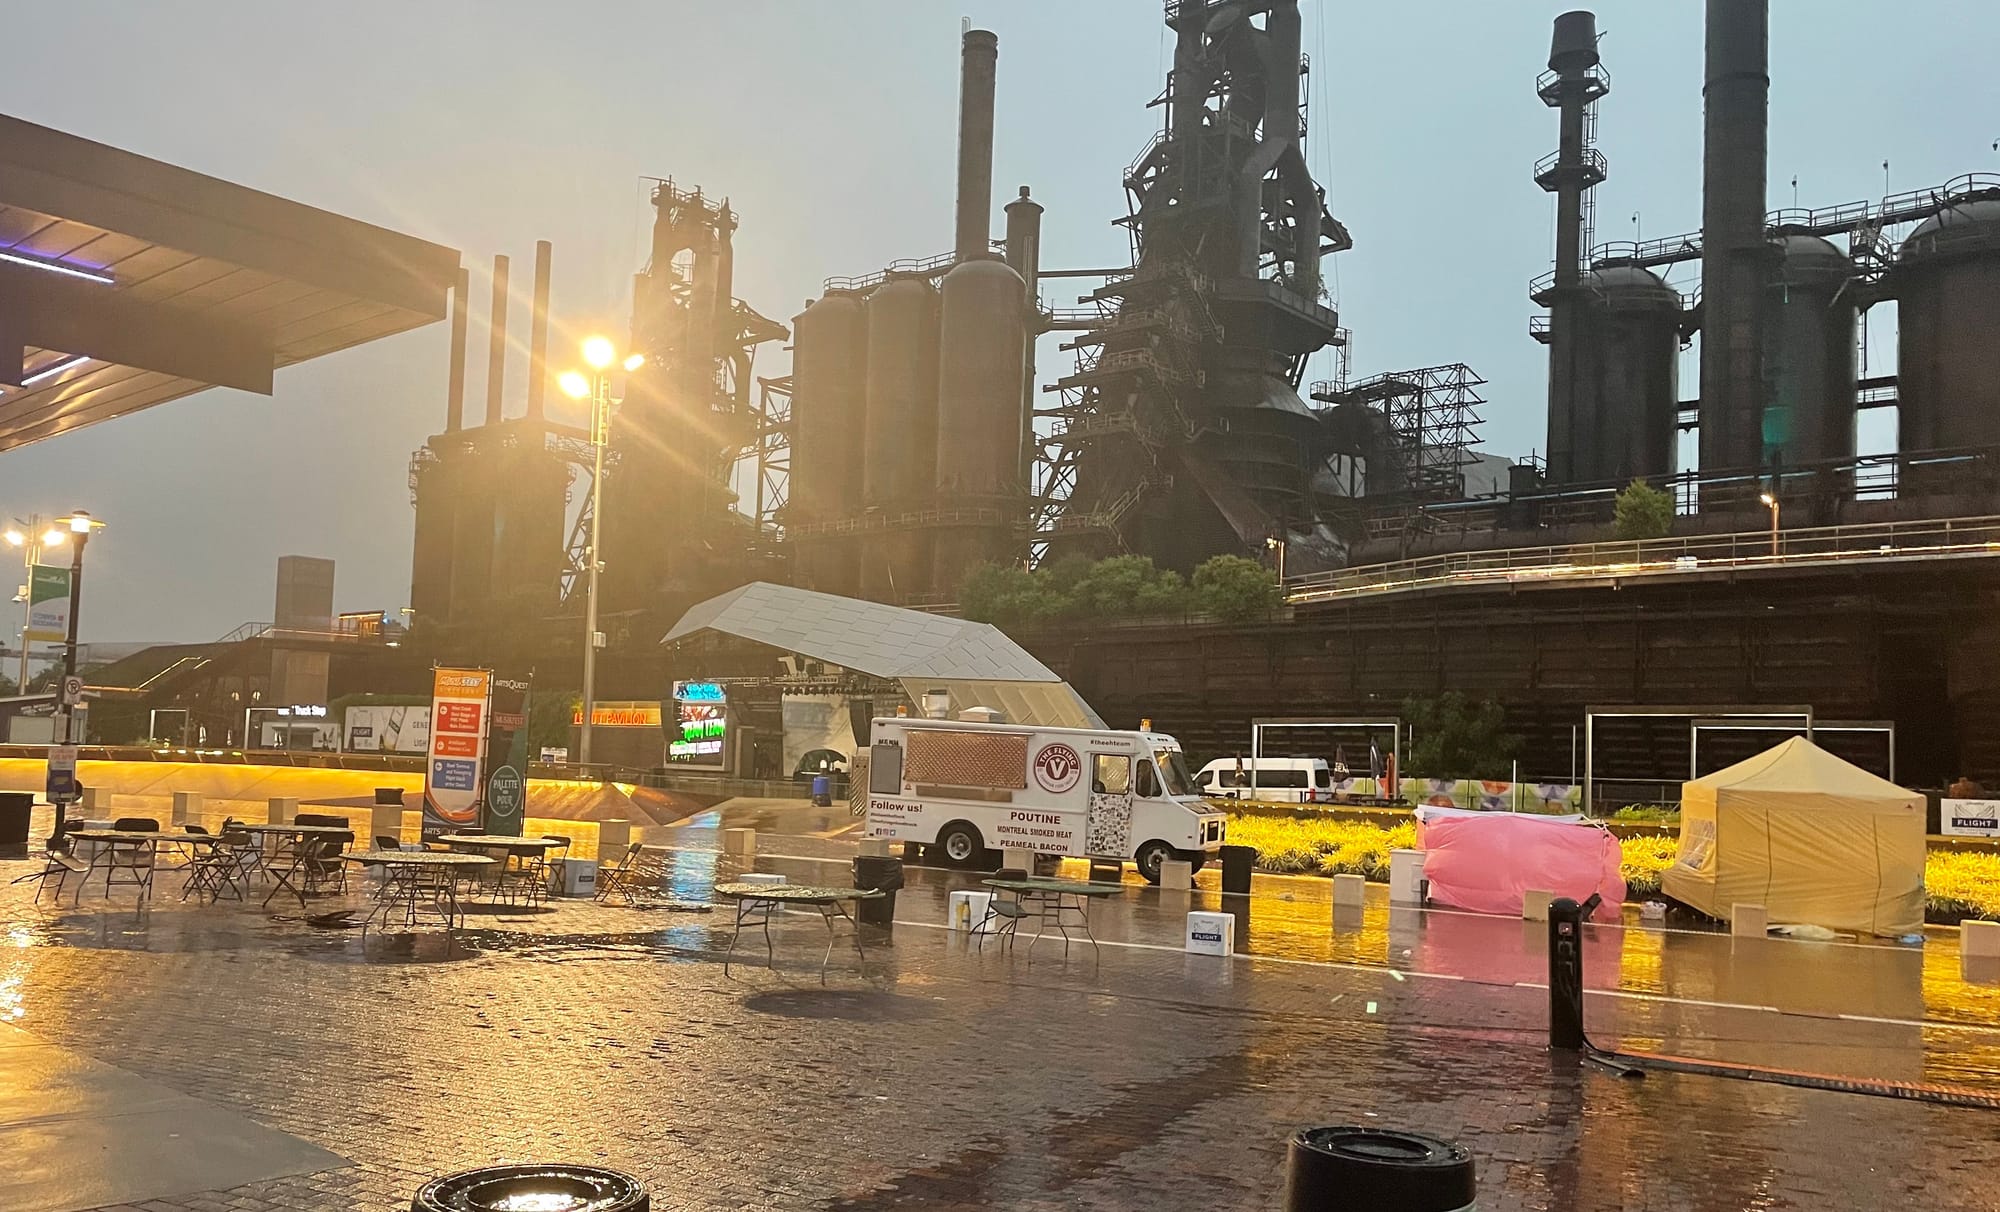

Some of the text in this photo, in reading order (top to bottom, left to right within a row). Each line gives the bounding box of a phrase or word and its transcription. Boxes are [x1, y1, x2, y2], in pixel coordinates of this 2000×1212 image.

[606, 712, 648, 725] PAVILION
[1054, 747, 1077, 766] FLYING
[1050, 757, 1067, 779] V
[493, 779, 519, 791] PALETTE
[871, 800, 923, 813] Follow us!
[1010, 811, 1061, 825] POUTINE
[1957, 819, 1993, 827] FLIGHT
[997, 825, 1073, 839] MONTREAL SMOKED MEAT
[1000, 839, 1069, 852] PEAMEAL BACON
